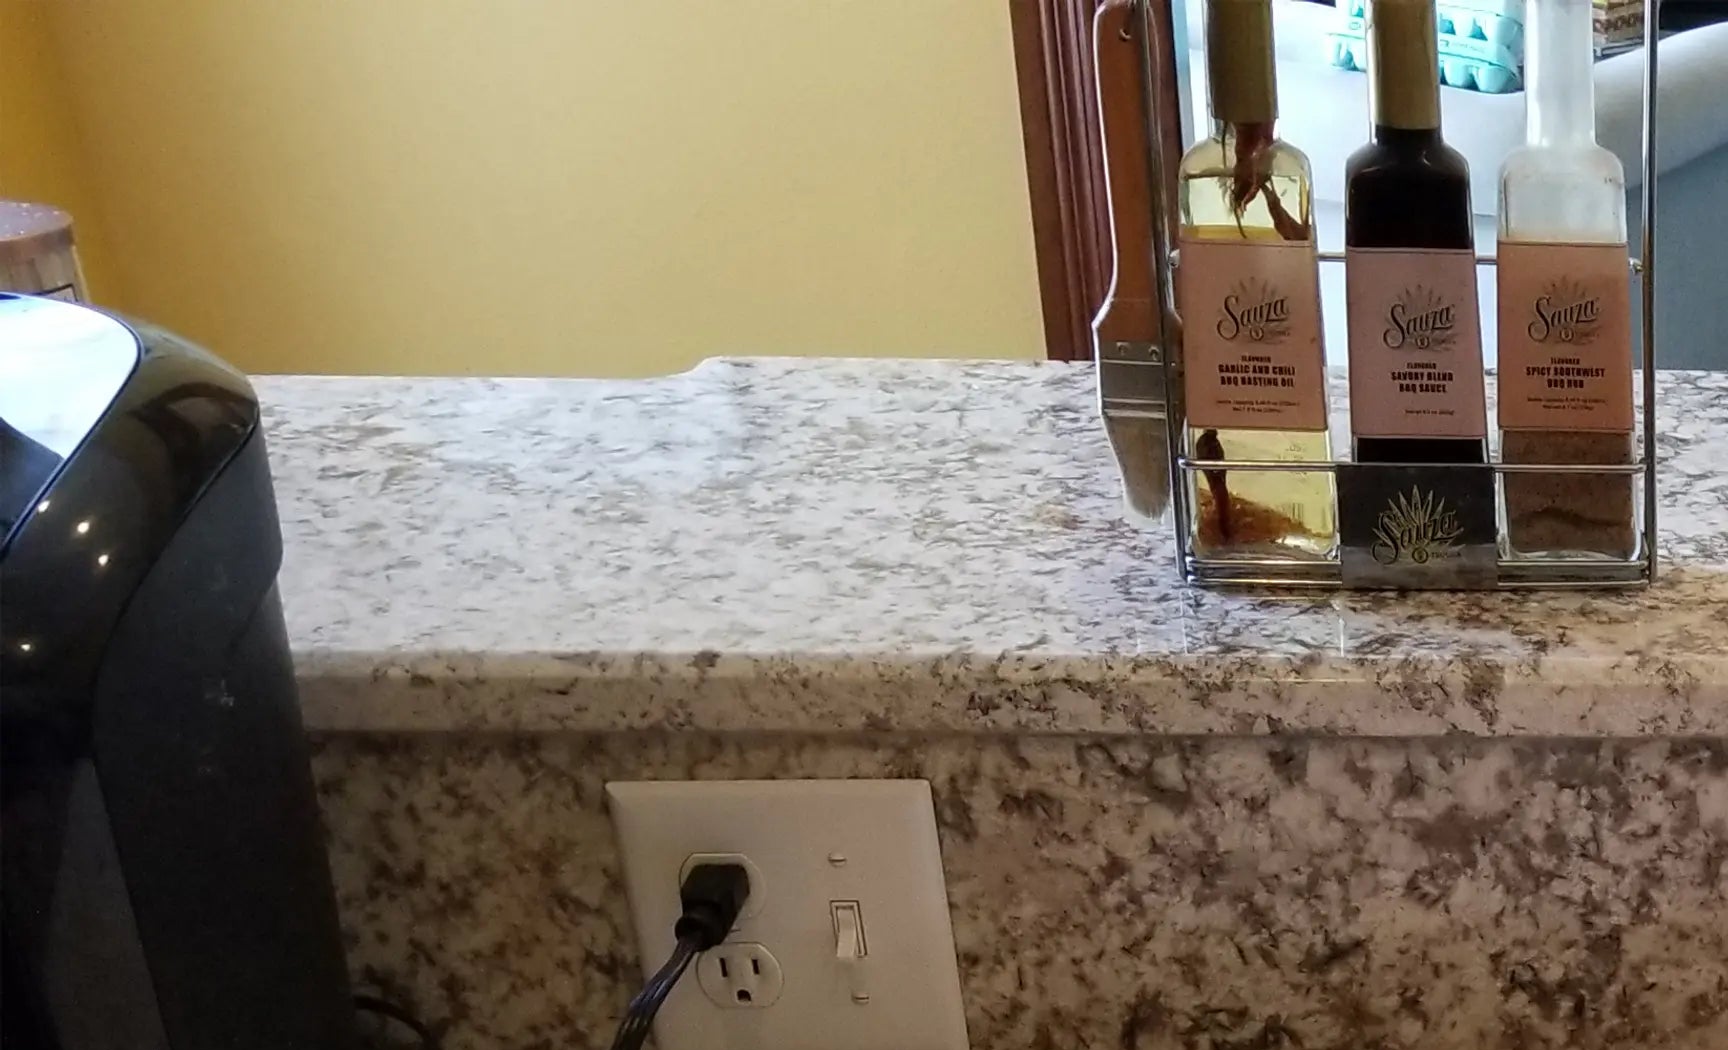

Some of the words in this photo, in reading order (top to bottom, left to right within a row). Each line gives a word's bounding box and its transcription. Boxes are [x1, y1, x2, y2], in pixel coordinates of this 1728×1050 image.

[1217, 295, 1289, 340] Sauza
[1527, 296, 1600, 341] Sauza
[1383, 304, 1455, 349] Sauza
[1218, 364, 1251, 374] GARLIC
[1252, 364, 1270, 375] AND
[1526, 366, 1551, 376] SPICY
[1553, 367, 1606, 377] SOUTHWEST
[1220, 376, 1239, 387] BBQ
[1240, 376, 1279, 387] BASTING
[1281, 377, 1295, 388] OIL
[1391, 371, 1425, 381] SAVORY
[1427, 372, 1454, 382] BLEND
[1399, 383, 1417, 394] BBQ
[1418, 383, 1447, 394] SAUCE
[1547, 378, 1565, 389] BBQ
[1371, 510, 1461, 565] Sauza
